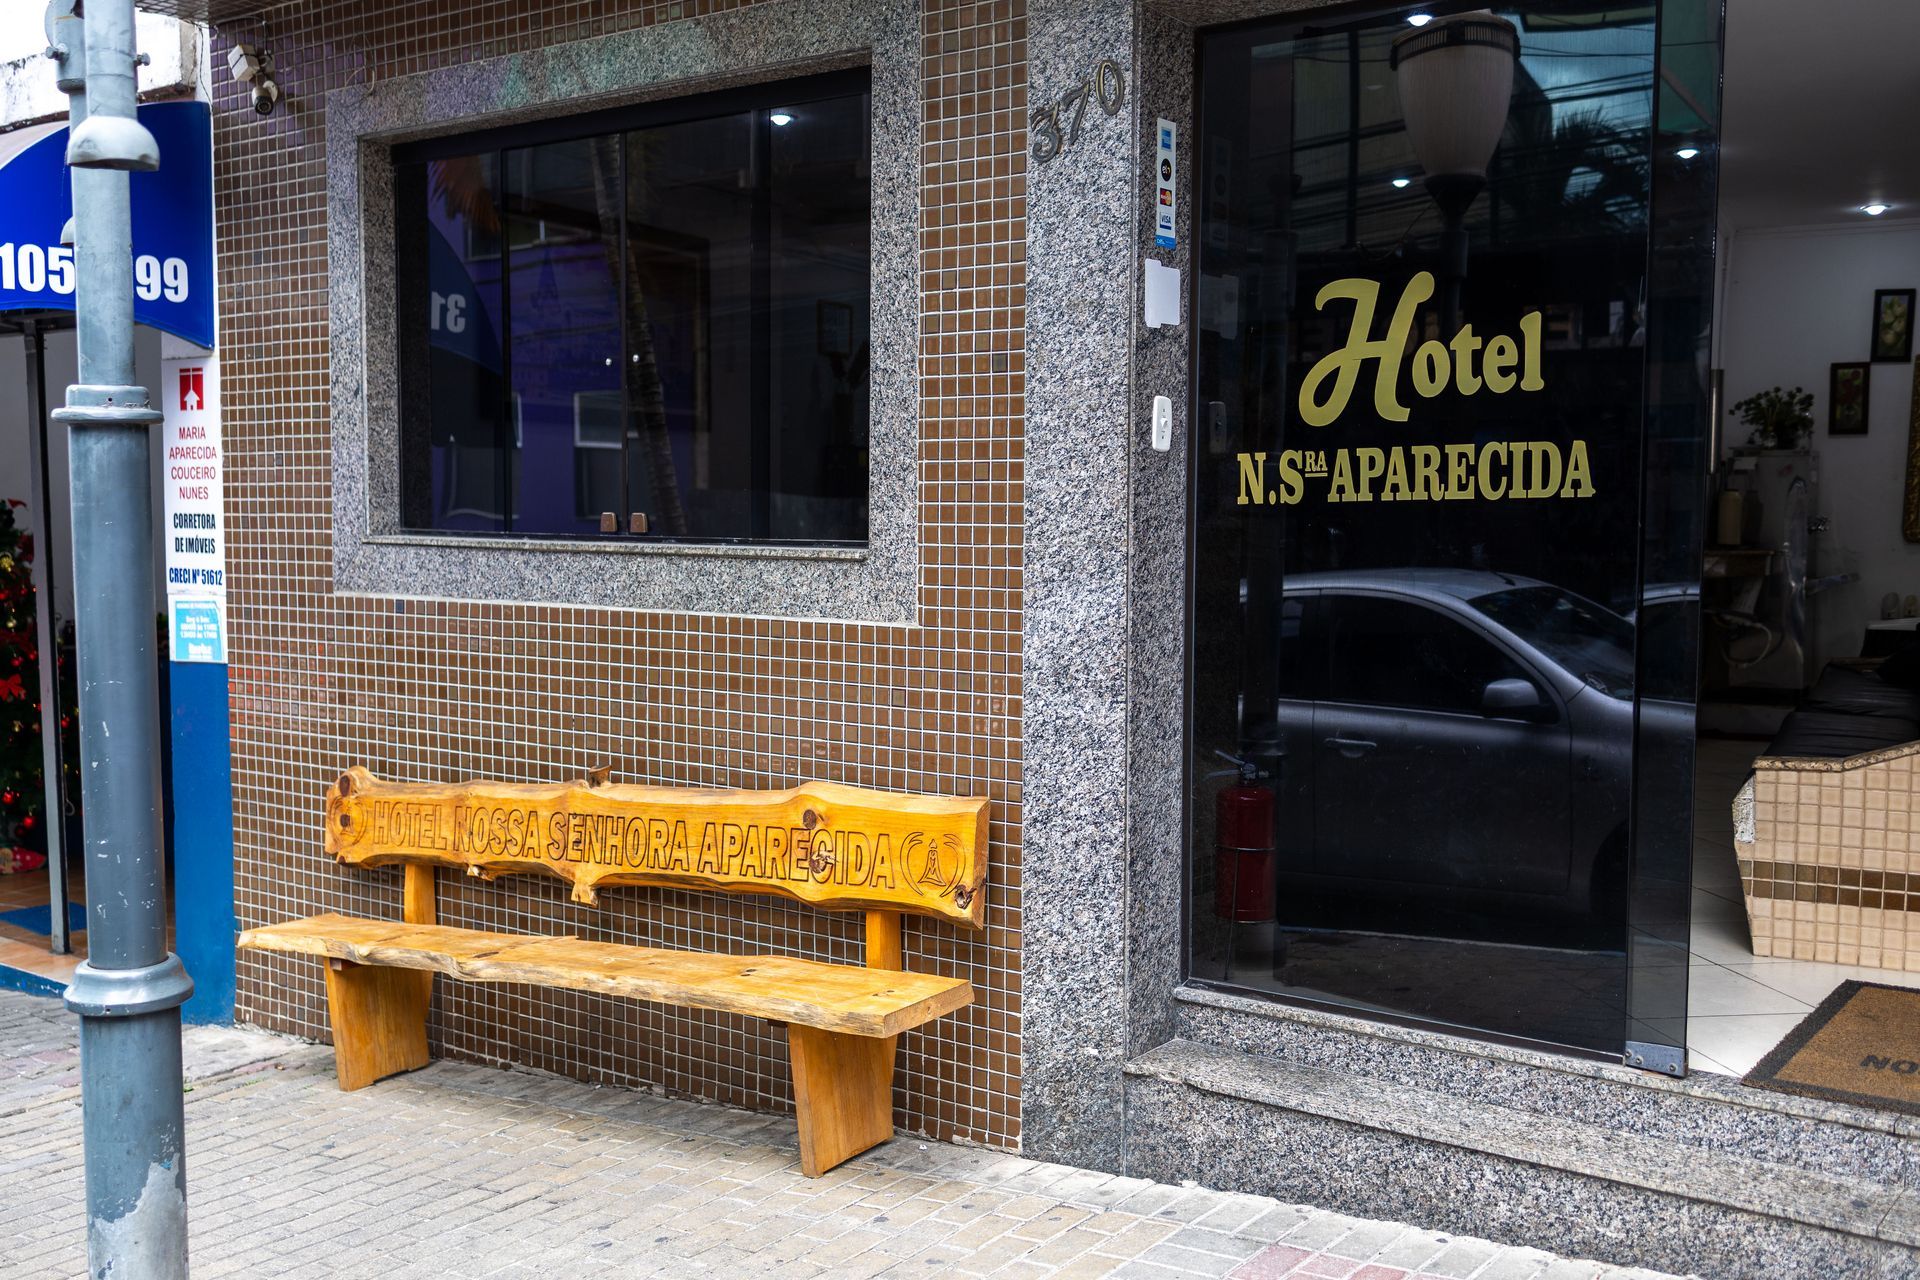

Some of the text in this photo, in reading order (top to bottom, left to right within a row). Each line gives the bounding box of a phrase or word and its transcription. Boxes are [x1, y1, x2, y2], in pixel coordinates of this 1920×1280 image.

[1031, 58, 1125, 164] 370
[1298, 270, 1545, 427] Hotel
[179, 426, 206, 440] MARIA
[169, 446, 217, 460] APARECIDA
[171, 466, 216, 480] COUCEIRO
[1327, 440, 1596, 502] APARECIDA
[179, 486, 209, 500] NUNES
[173, 513, 216, 529] CORRETORA
[175, 534, 216, 554] DE IMÓVEIS
[169, 567, 191, 584] CRECI
[201, 569, 223, 586] 51612
[373, 800, 895, 889] HOTEL NOSSA SENHORA APARECIDA
